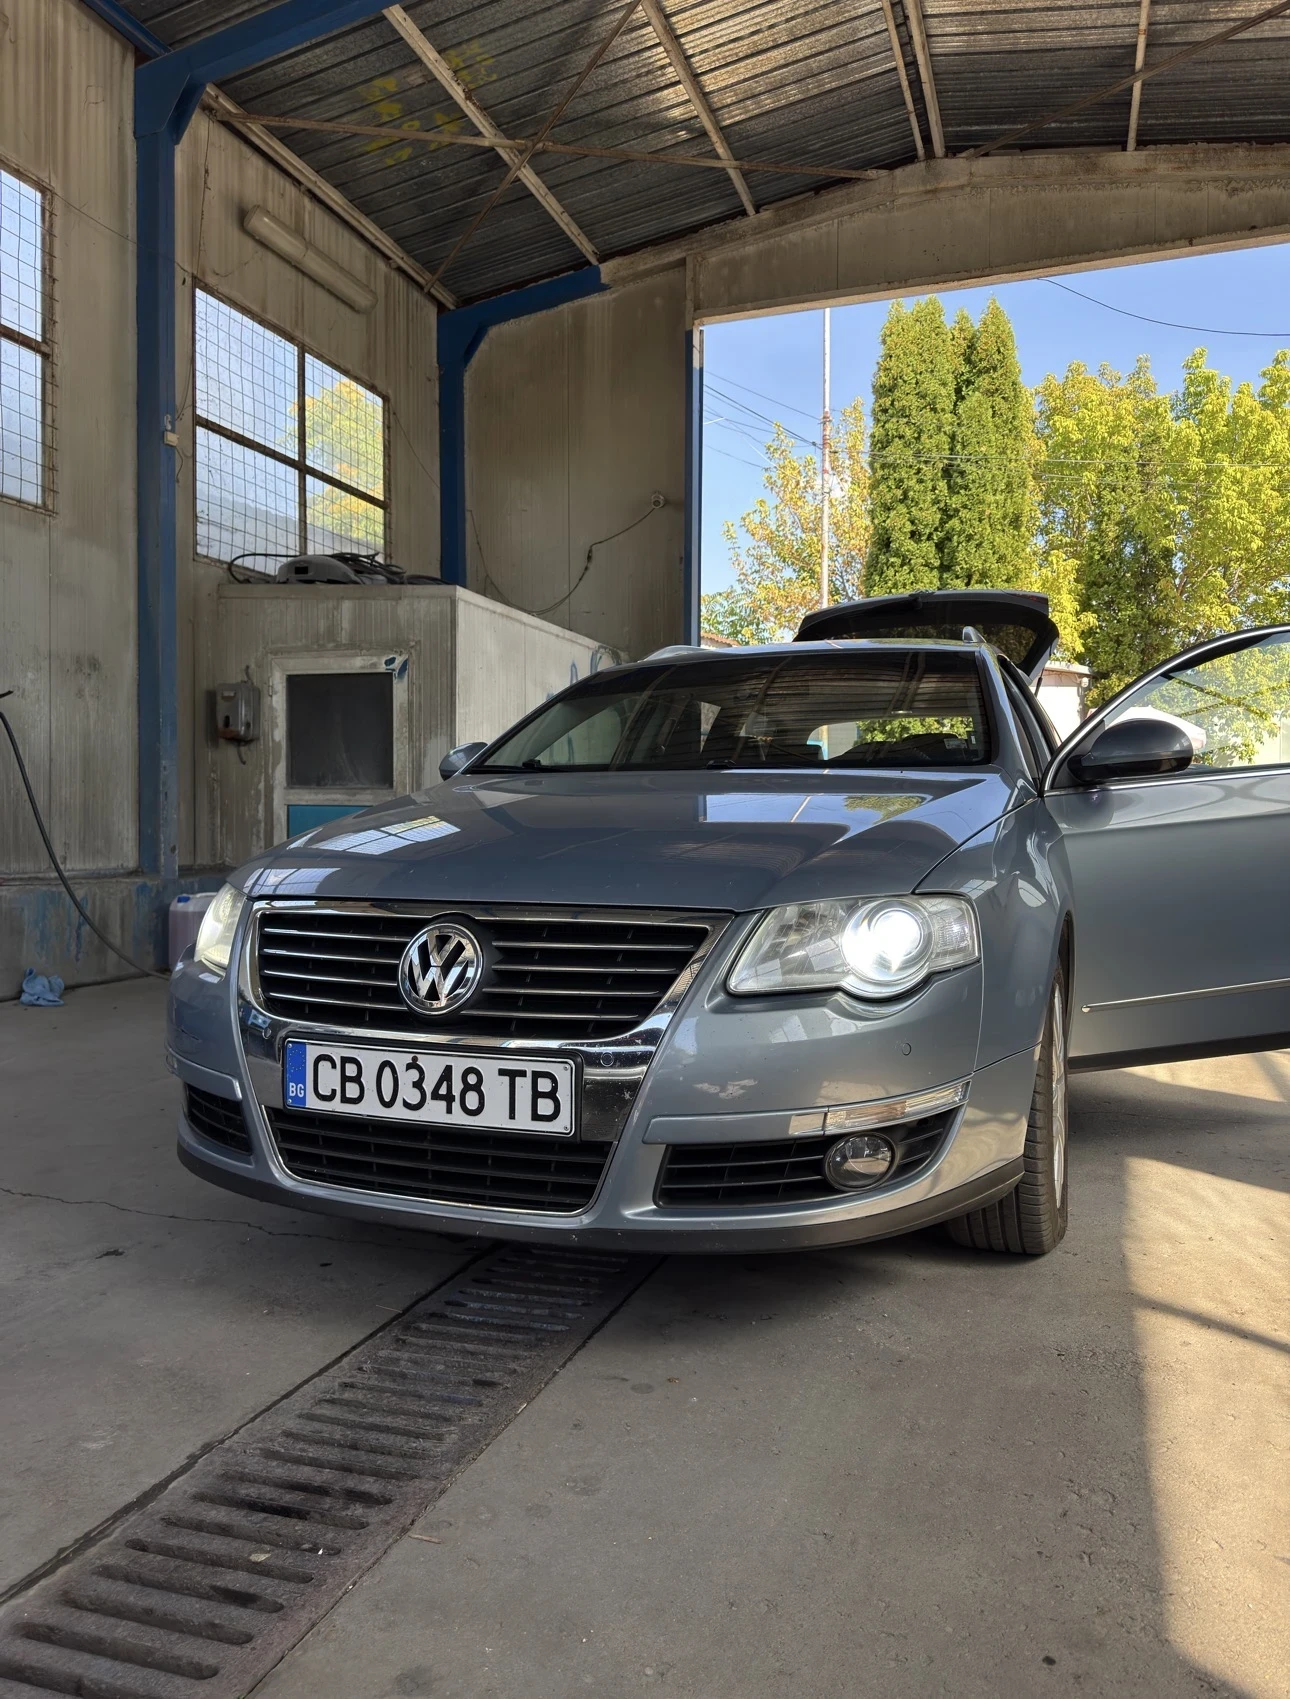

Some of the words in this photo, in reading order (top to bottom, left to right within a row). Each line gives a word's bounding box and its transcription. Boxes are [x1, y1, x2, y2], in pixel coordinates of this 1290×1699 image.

[404, 927, 478, 1010] VW
[289, 1082, 304, 1098] BG
[312, 1053, 365, 1105] CB
[376, 1058, 486, 1117] 0348
[498, 1067, 562, 1123] TB
